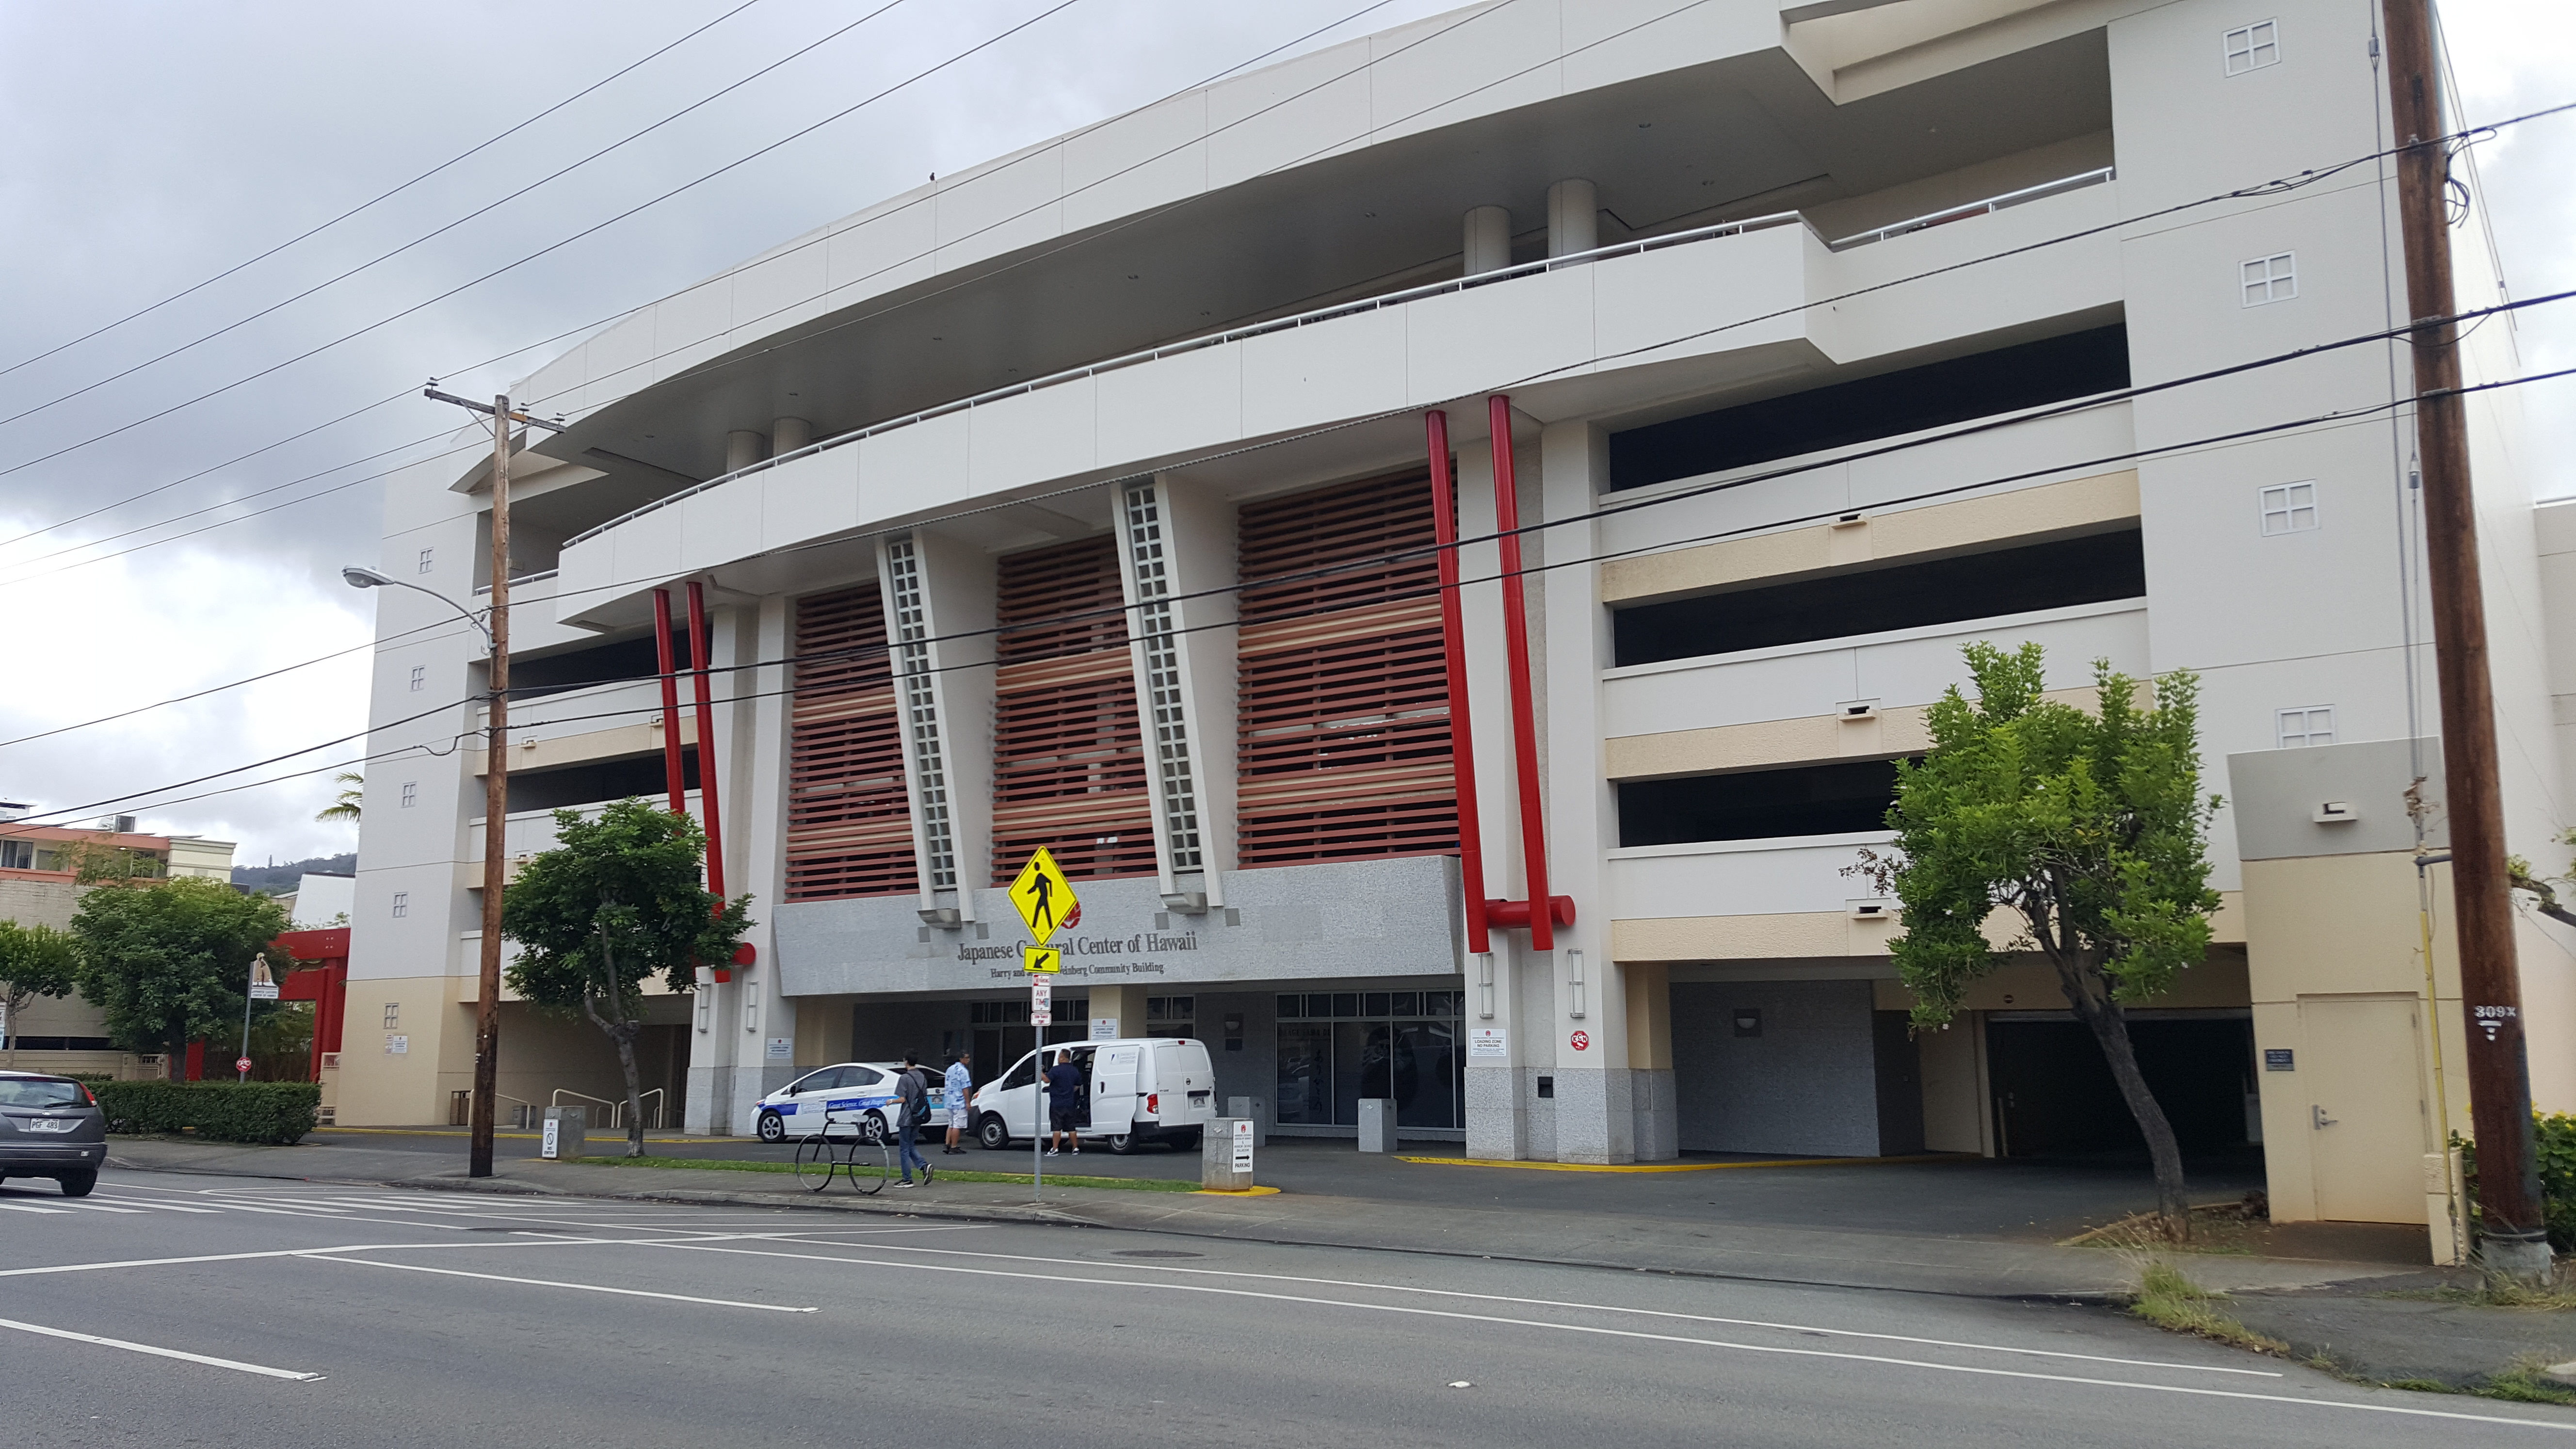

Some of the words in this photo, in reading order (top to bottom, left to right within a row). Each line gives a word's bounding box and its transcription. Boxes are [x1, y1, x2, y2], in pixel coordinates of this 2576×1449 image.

[958, 943, 1014, 965] Japanese
[1078, 936, 1123, 955] Center
[1127, 934, 1141, 953] of
[1145, 931, 1198, 952] Hawaii
[990, 968, 1011, 979] Harry
[1089, 964, 1130, 975] Community
[1132, 962, 1164, 974] Building
